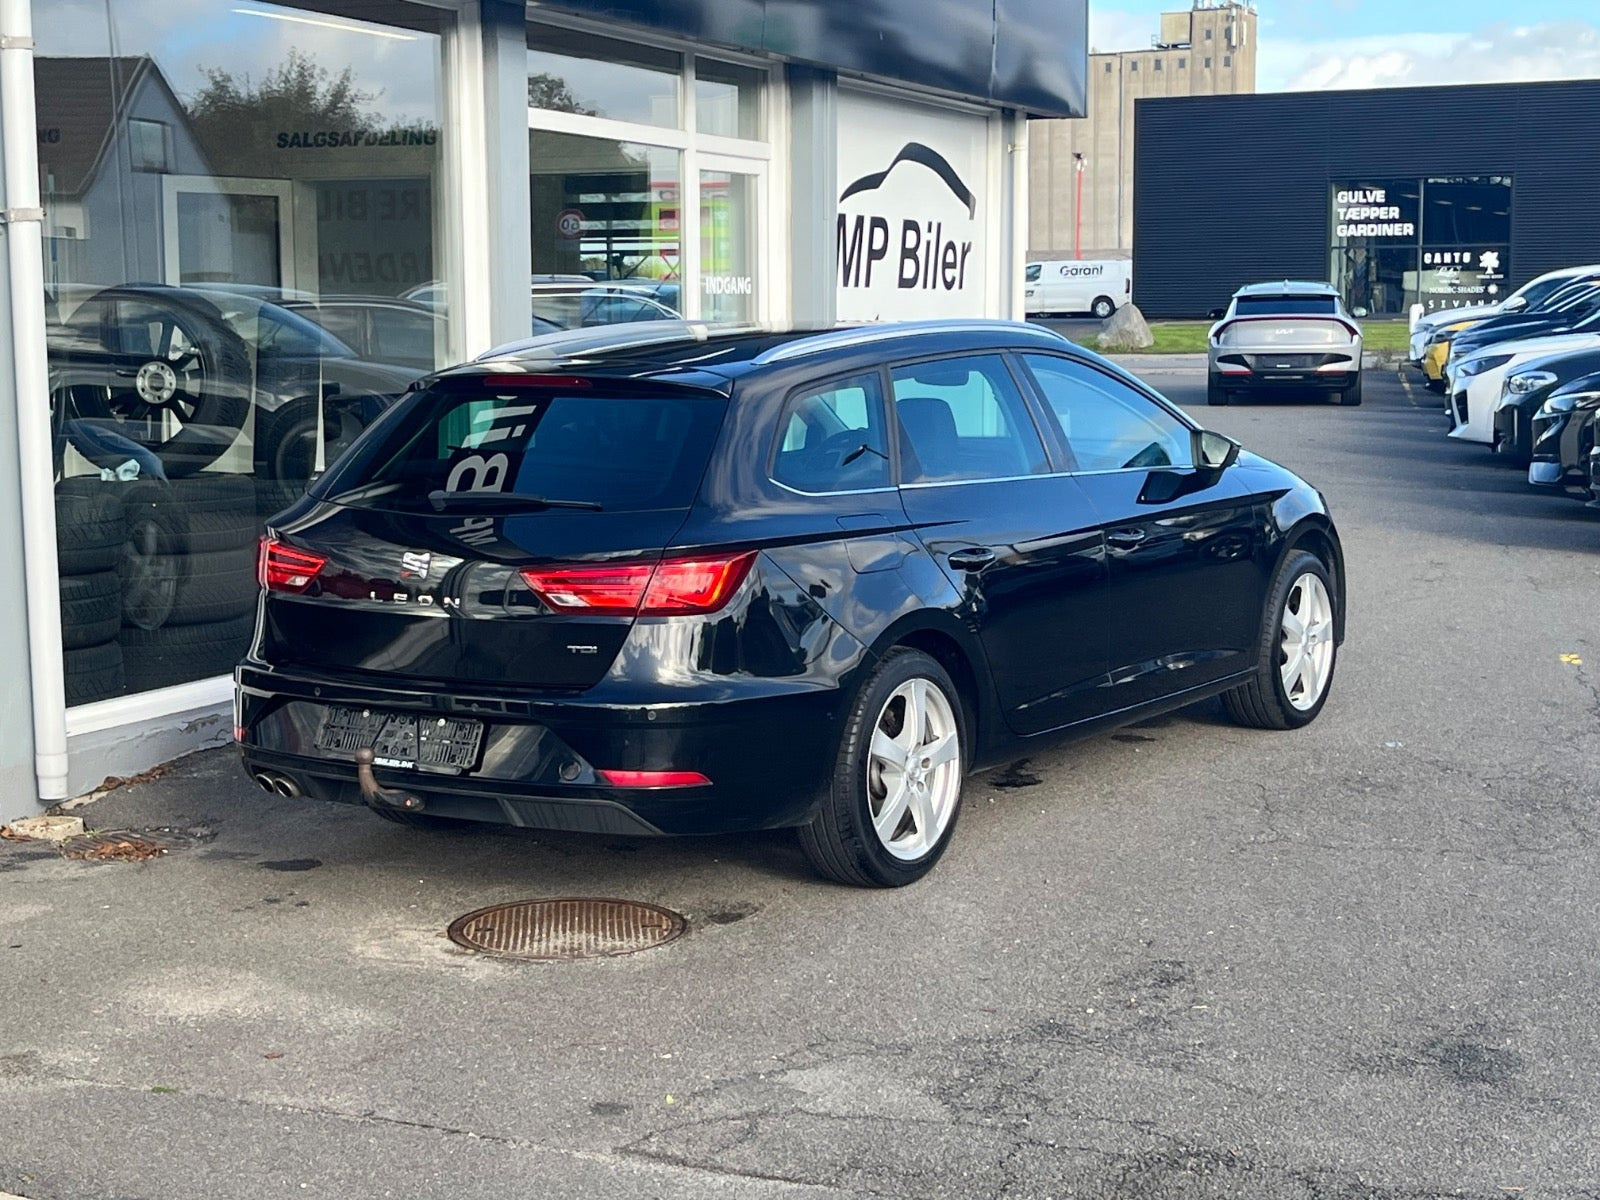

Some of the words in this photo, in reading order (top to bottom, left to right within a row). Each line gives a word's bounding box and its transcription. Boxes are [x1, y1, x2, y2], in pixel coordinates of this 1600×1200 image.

[1336, 189, 1386, 204] GULVE
[1336, 206, 1400, 220] TÆPPER
[1335, 222, 1415, 238] GARDINER
[837, 212, 889, 288] MP
[897, 218, 972, 291] Biler
[1060, 264, 1103, 276] Garant
[705, 276, 752, 295] INDGANG
[370, 591, 461, 609] LEON
[566, 645, 598, 654] TDI
